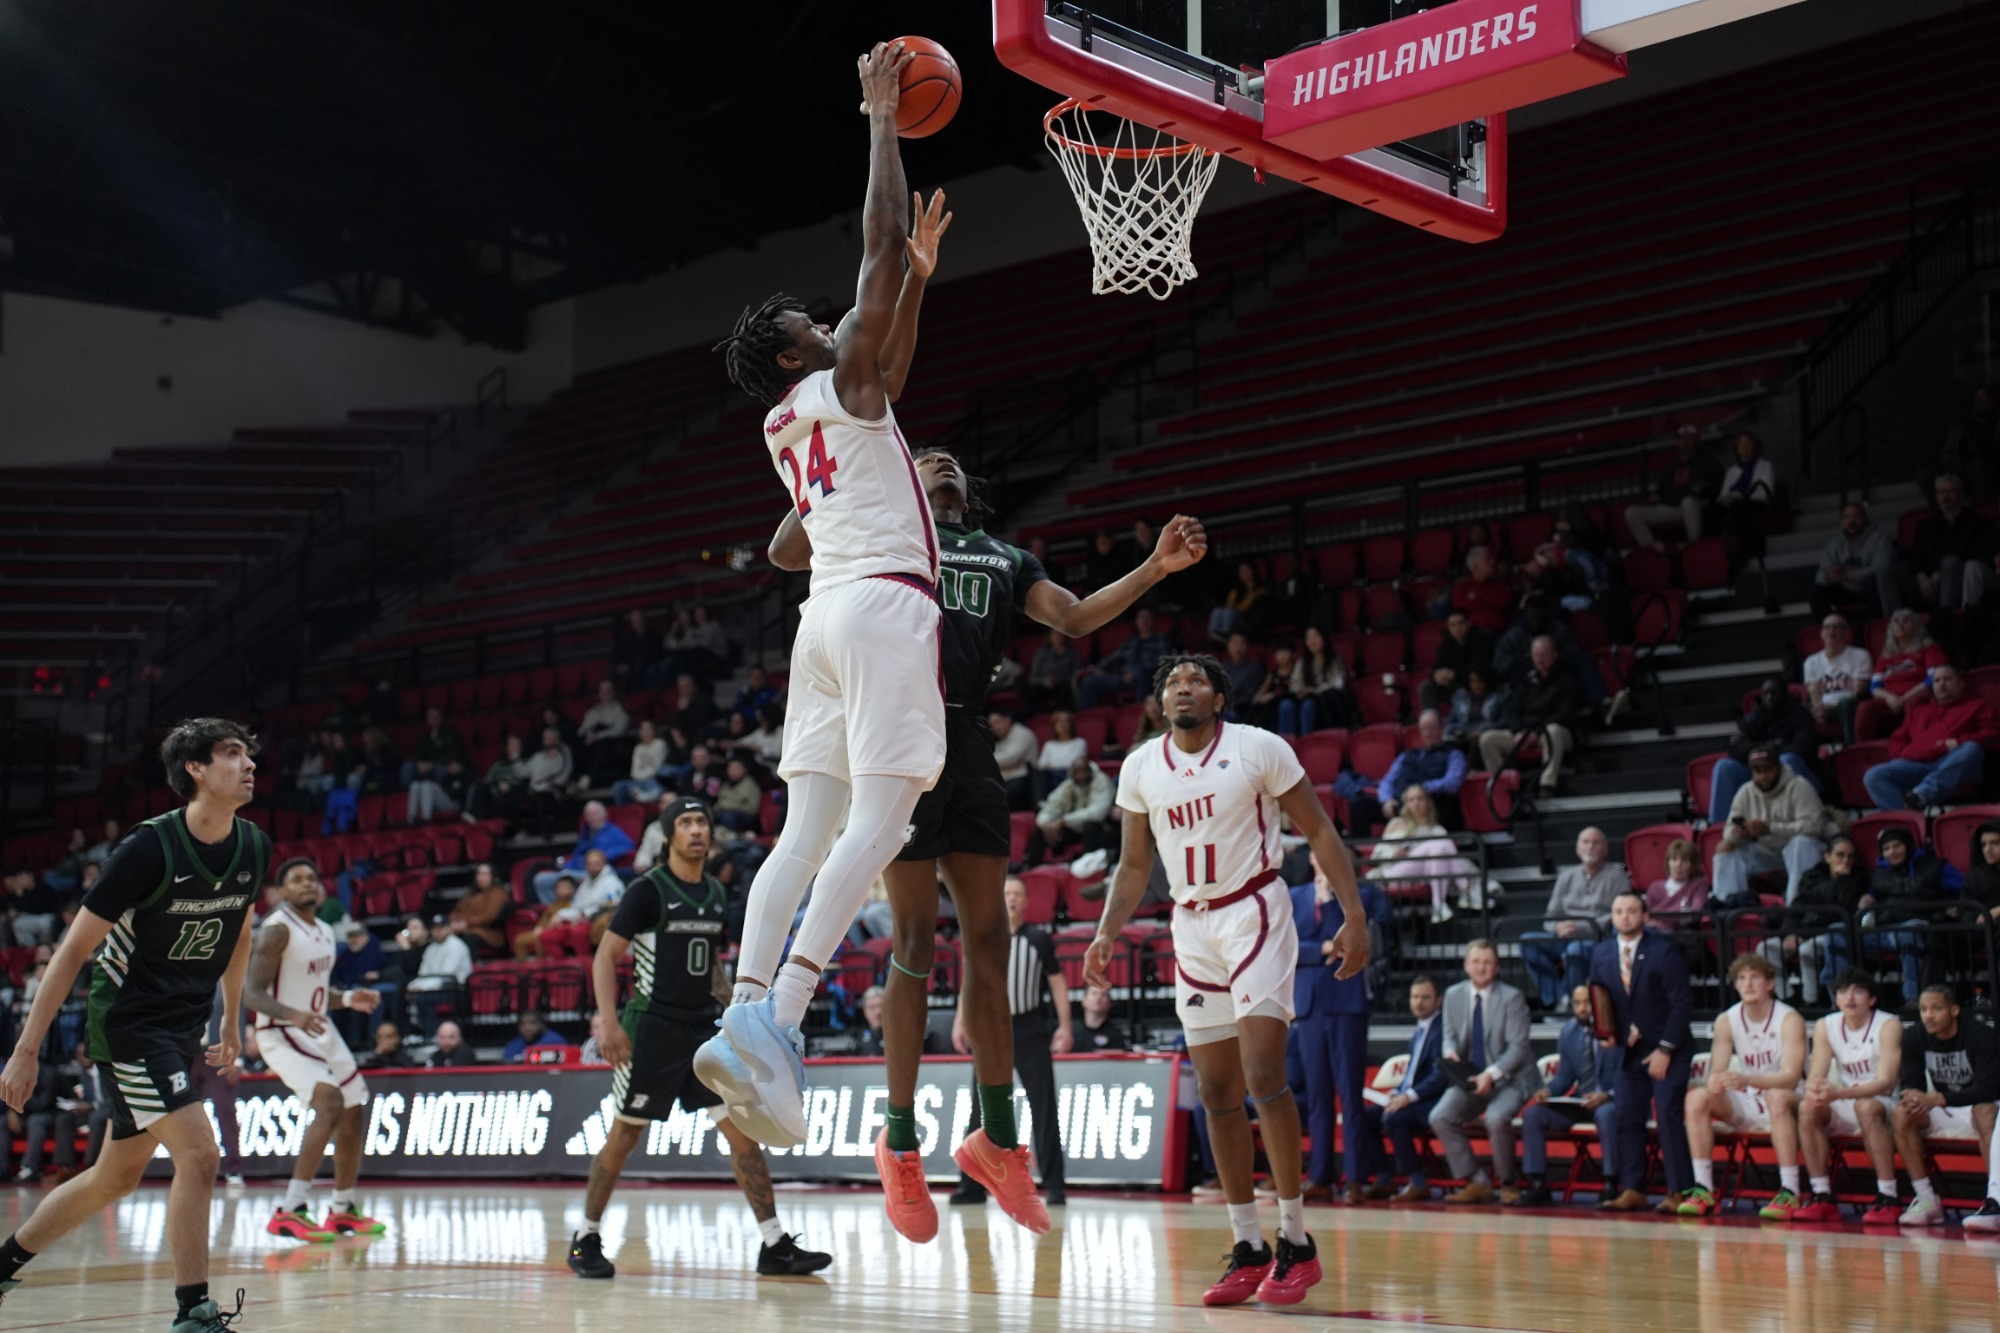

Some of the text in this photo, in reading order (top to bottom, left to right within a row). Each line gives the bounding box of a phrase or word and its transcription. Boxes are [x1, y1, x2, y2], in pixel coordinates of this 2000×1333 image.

[1292, 4, 1537, 106] HIGHLANDERS
[778, 420, 838, 521] 24
[939, 551, 1010, 570] GHAMTON
[939, 566, 992, 618] 10
[1167, 793, 1216, 831] NJIT
[1185, 844, 1217, 886] 11
[169, 896, 246, 913] BINGHAMTON
[168, 918, 223, 960] 12
[687, 937, 710, 976] 0
[310, 985, 325, 1012] 0
[1744, 1051, 1772, 1070] NJIT
[168, 1071, 188, 1095] B
[364, 1092, 405, 1156] IS
[404, 1089, 553, 1156] NOTHING
